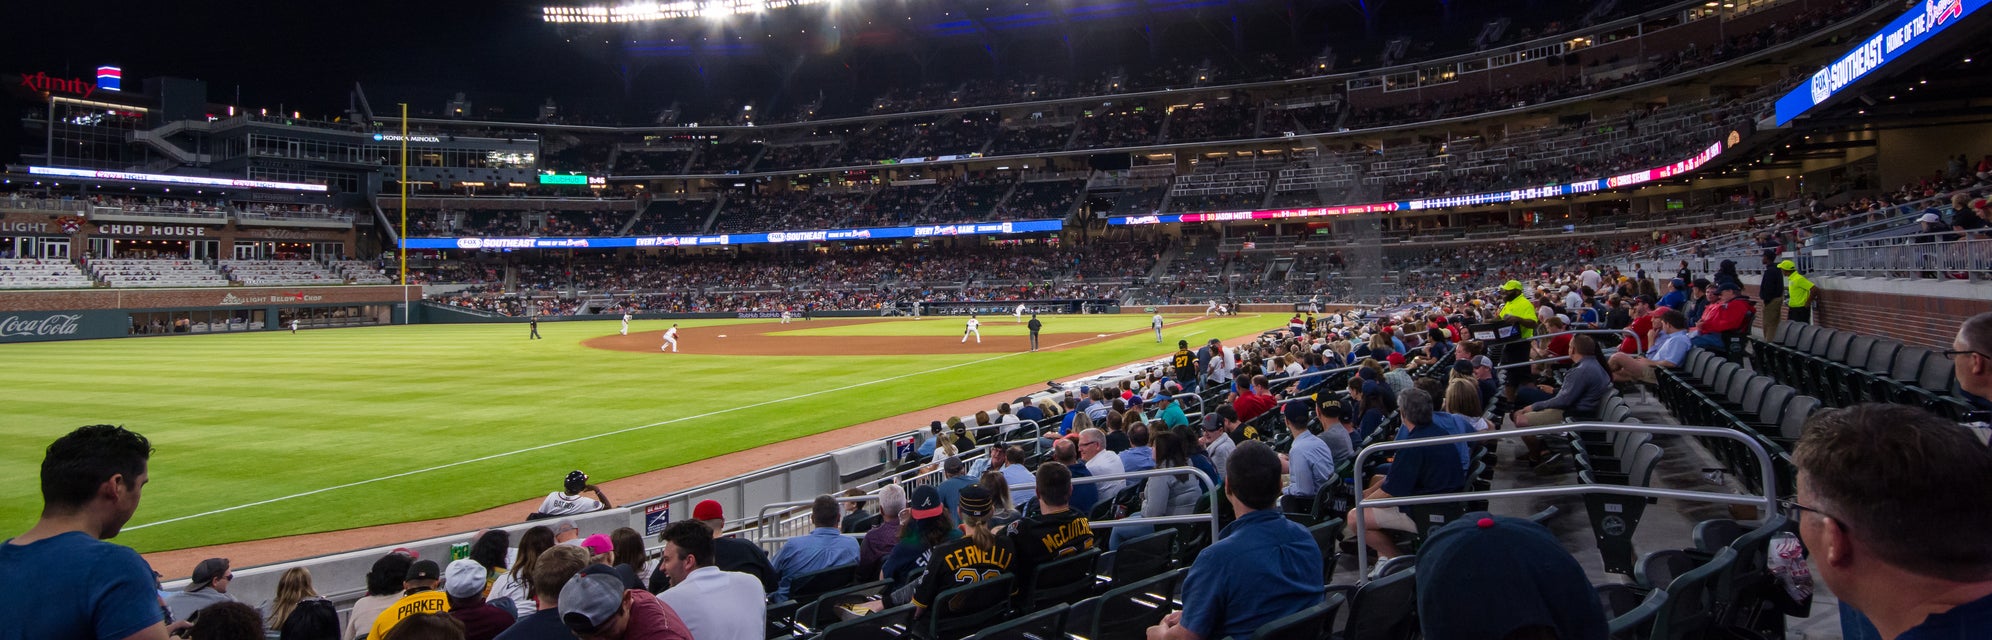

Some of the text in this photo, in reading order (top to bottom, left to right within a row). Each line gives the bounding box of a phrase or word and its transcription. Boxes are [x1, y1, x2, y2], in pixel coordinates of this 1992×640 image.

[1886, 27, 1904, 54] HOME
[1904, 21, 1913, 43] OF
[1913, 13, 1926, 38] THE
[1831, 34, 1884, 91] SOUTHEAST
[21, 71, 97, 99] xfinity
[2, 222, 48, 232] LIGHT
[99, 224, 205, 236] CHOP HOUSE
[915, 227, 934, 236] EVERY
[958, 225, 975, 234] GAME
[636, 237, 657, 246] EVERY
[680, 237, 698, 245] GAME
[786, 231, 828, 241] SOUTHEAST
[482, 239, 536, 248] SOUTHEAST
[0, 314, 83, 337] Coca-Cola
[1176, 355, 1189, 369] 27
[553, 499, 565, 508] BAT
[945, 545, 1013, 571] CERVELLI
[398, 598, 444, 620] PARKER
